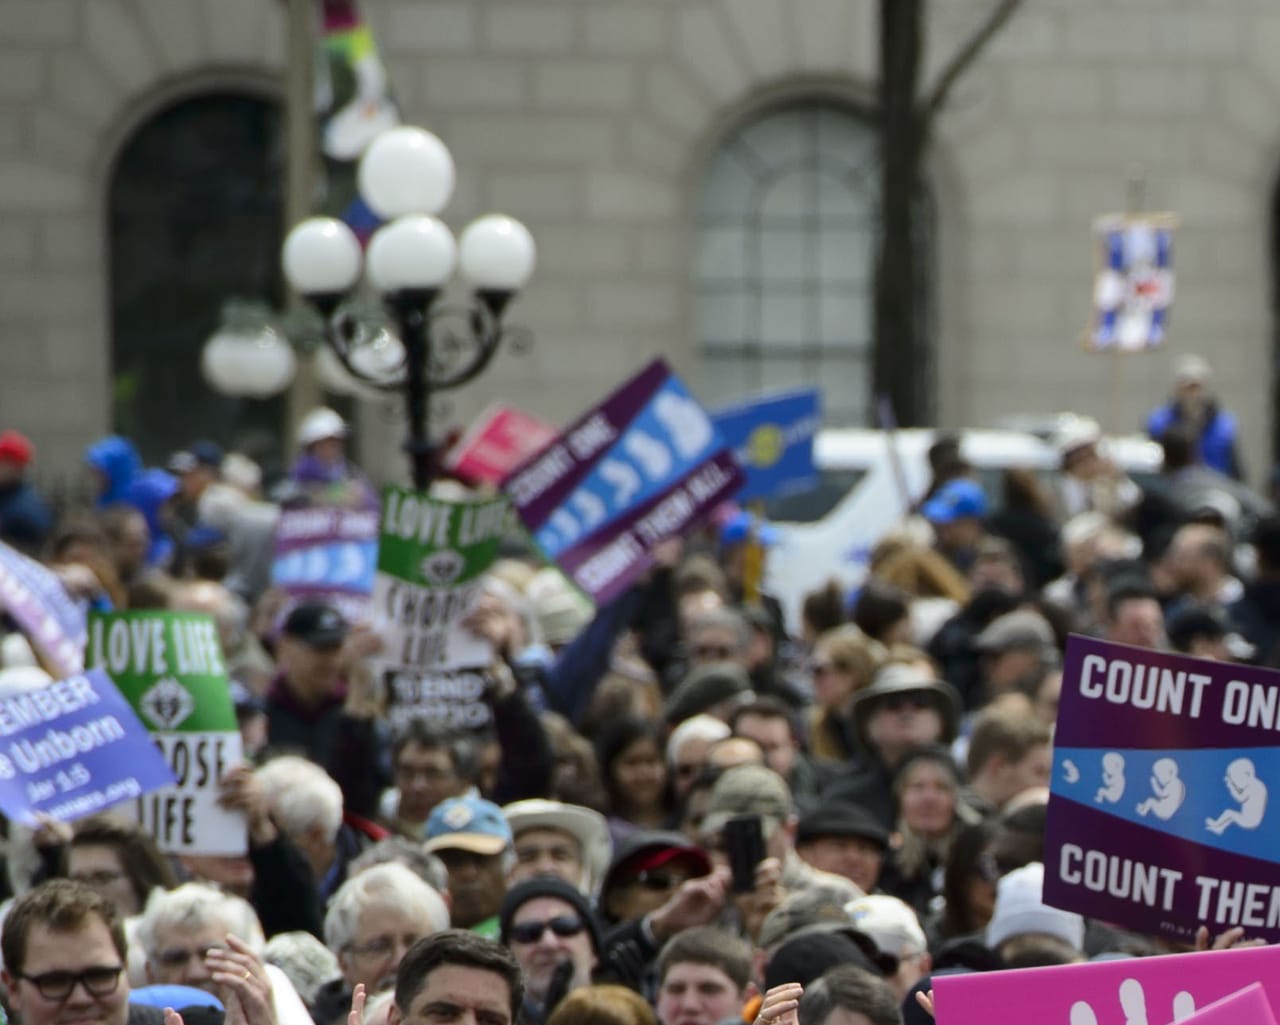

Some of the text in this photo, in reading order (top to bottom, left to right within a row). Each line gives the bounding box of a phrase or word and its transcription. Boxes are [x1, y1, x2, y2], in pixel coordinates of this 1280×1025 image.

[91, 617, 227, 677] LOVE LIFE
[1079, 653, 1212, 719] COUNT
[10, 714, 127, 775] Unborn
[1059, 842, 1183, 911] COUNT
